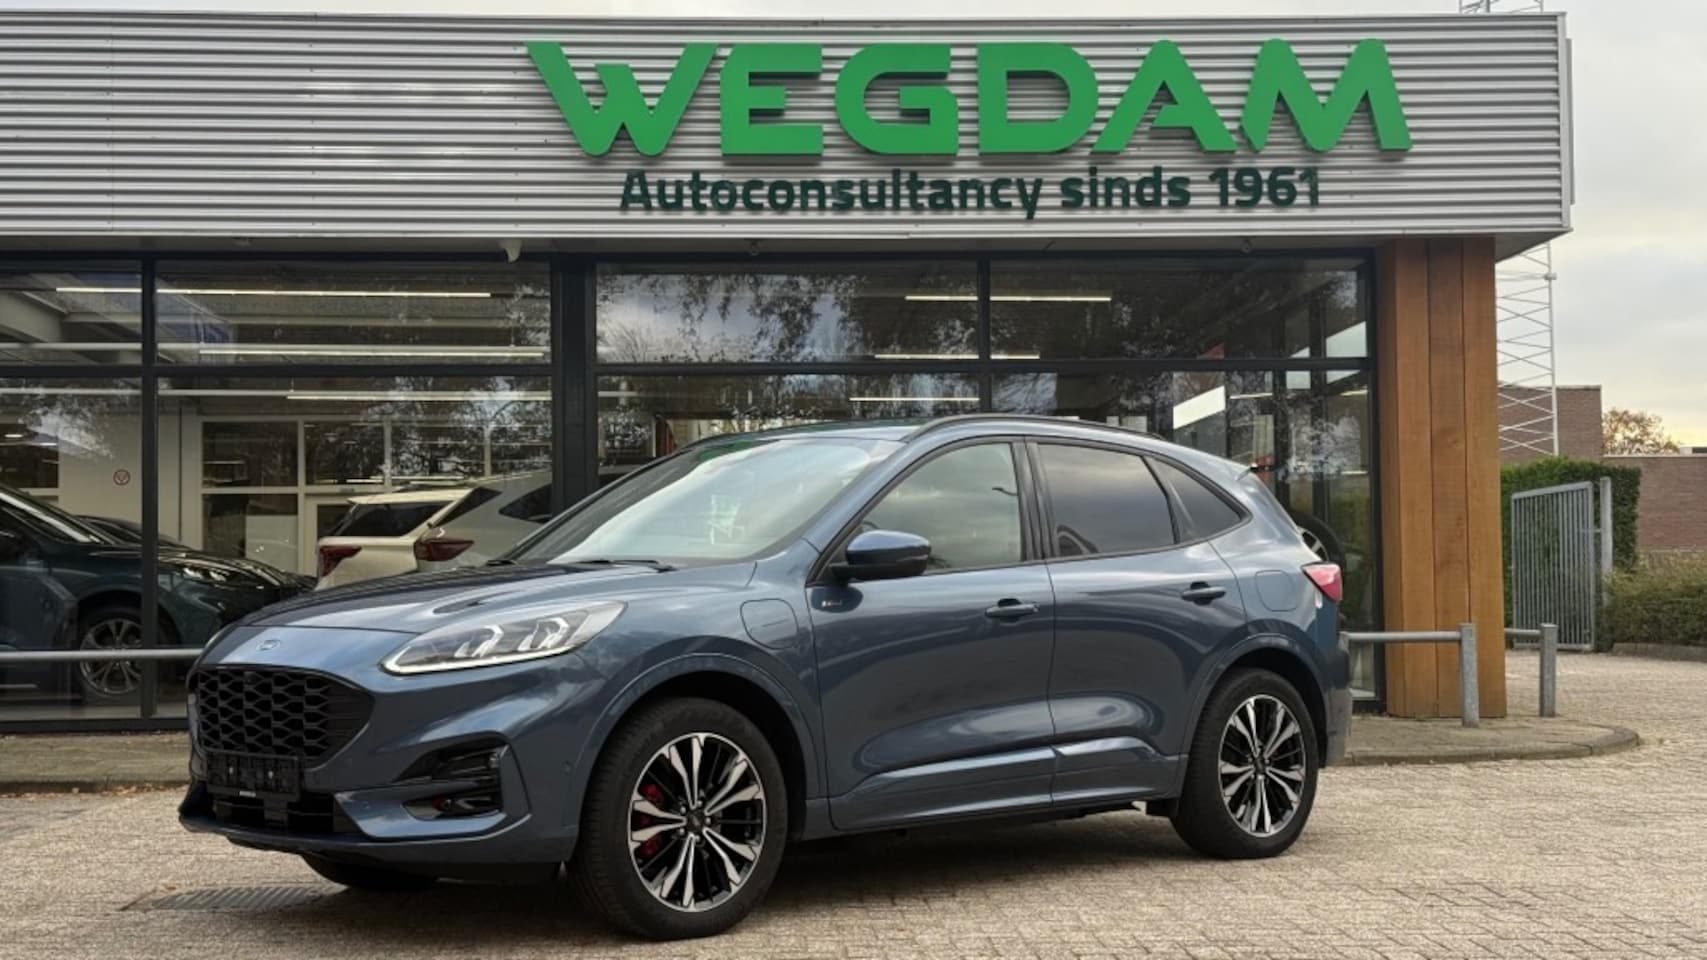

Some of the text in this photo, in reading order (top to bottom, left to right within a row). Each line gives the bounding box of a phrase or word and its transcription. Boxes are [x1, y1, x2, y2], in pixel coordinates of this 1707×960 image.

[526, 39, 1412, 157] WEGDAM
[621, 166, 1319, 220] Autoconsultancy sinds 1961
